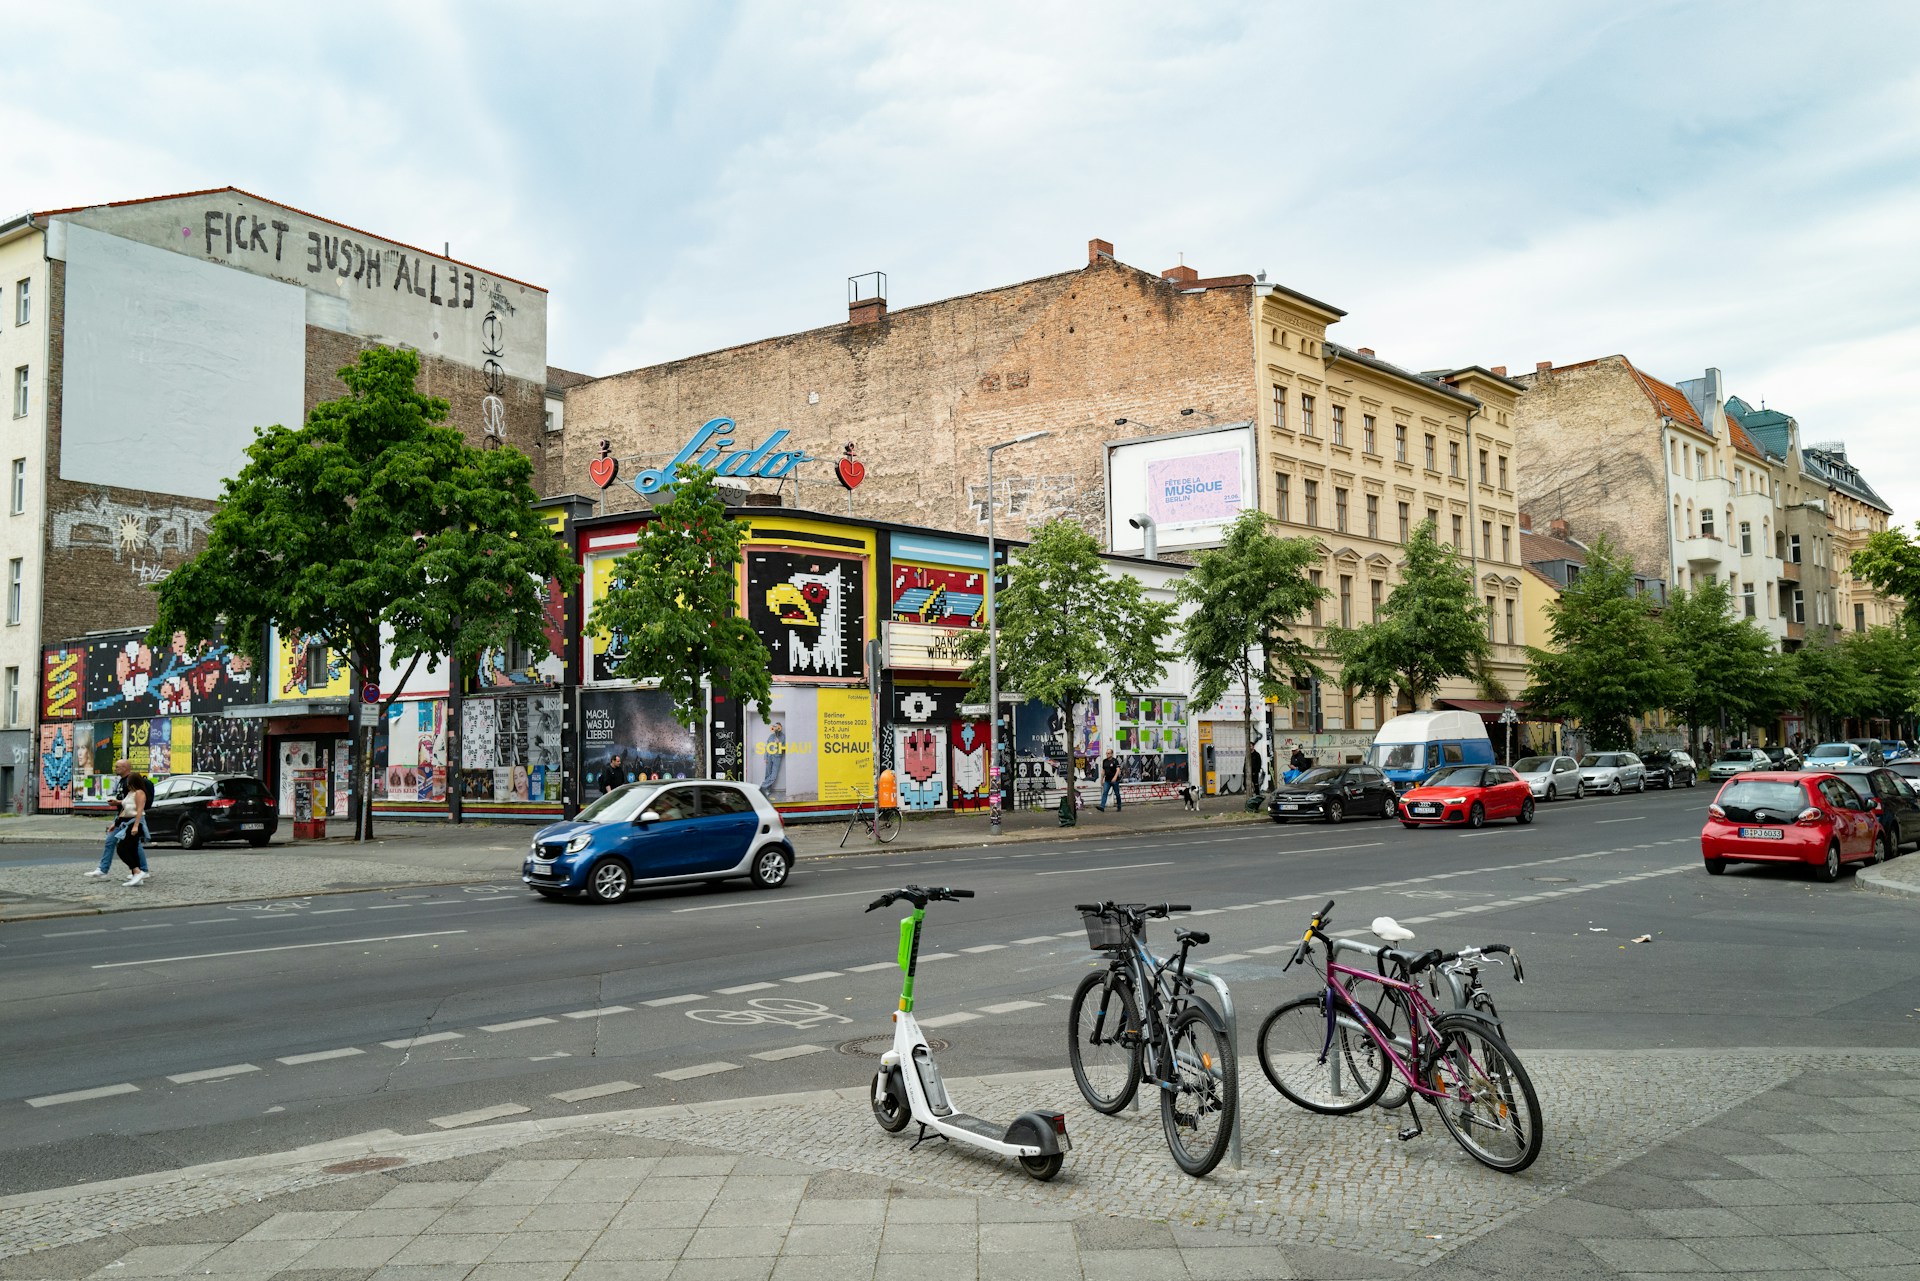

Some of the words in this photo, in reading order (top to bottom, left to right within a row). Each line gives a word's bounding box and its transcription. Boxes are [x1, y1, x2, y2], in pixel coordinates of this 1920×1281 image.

[205, 210, 290, 261] FICKT
[634, 416, 815, 495] Lido
[1164, 477, 1181, 487] FÊTE
[1182, 477, 1191, 486] DE
[1192, 476, 1201, 485] LA
[1164, 480, 1223, 497] MUSIQUE
[1165, 494, 1191, 504] BERLIN
[927, 646, 948, 660] WITH
[585, 709, 610, 720] MACH,
[586, 719, 603, 729] WAS
[603, 719, 615, 729] DU
[585, 729, 613, 740] LIEBST!
[754, 741, 813, 755] SCHAU!
[824, 741, 870, 754] SCHAU!
[1753, 829, 1763, 837] PJ
[1763, 829, 1781, 838] 6033
